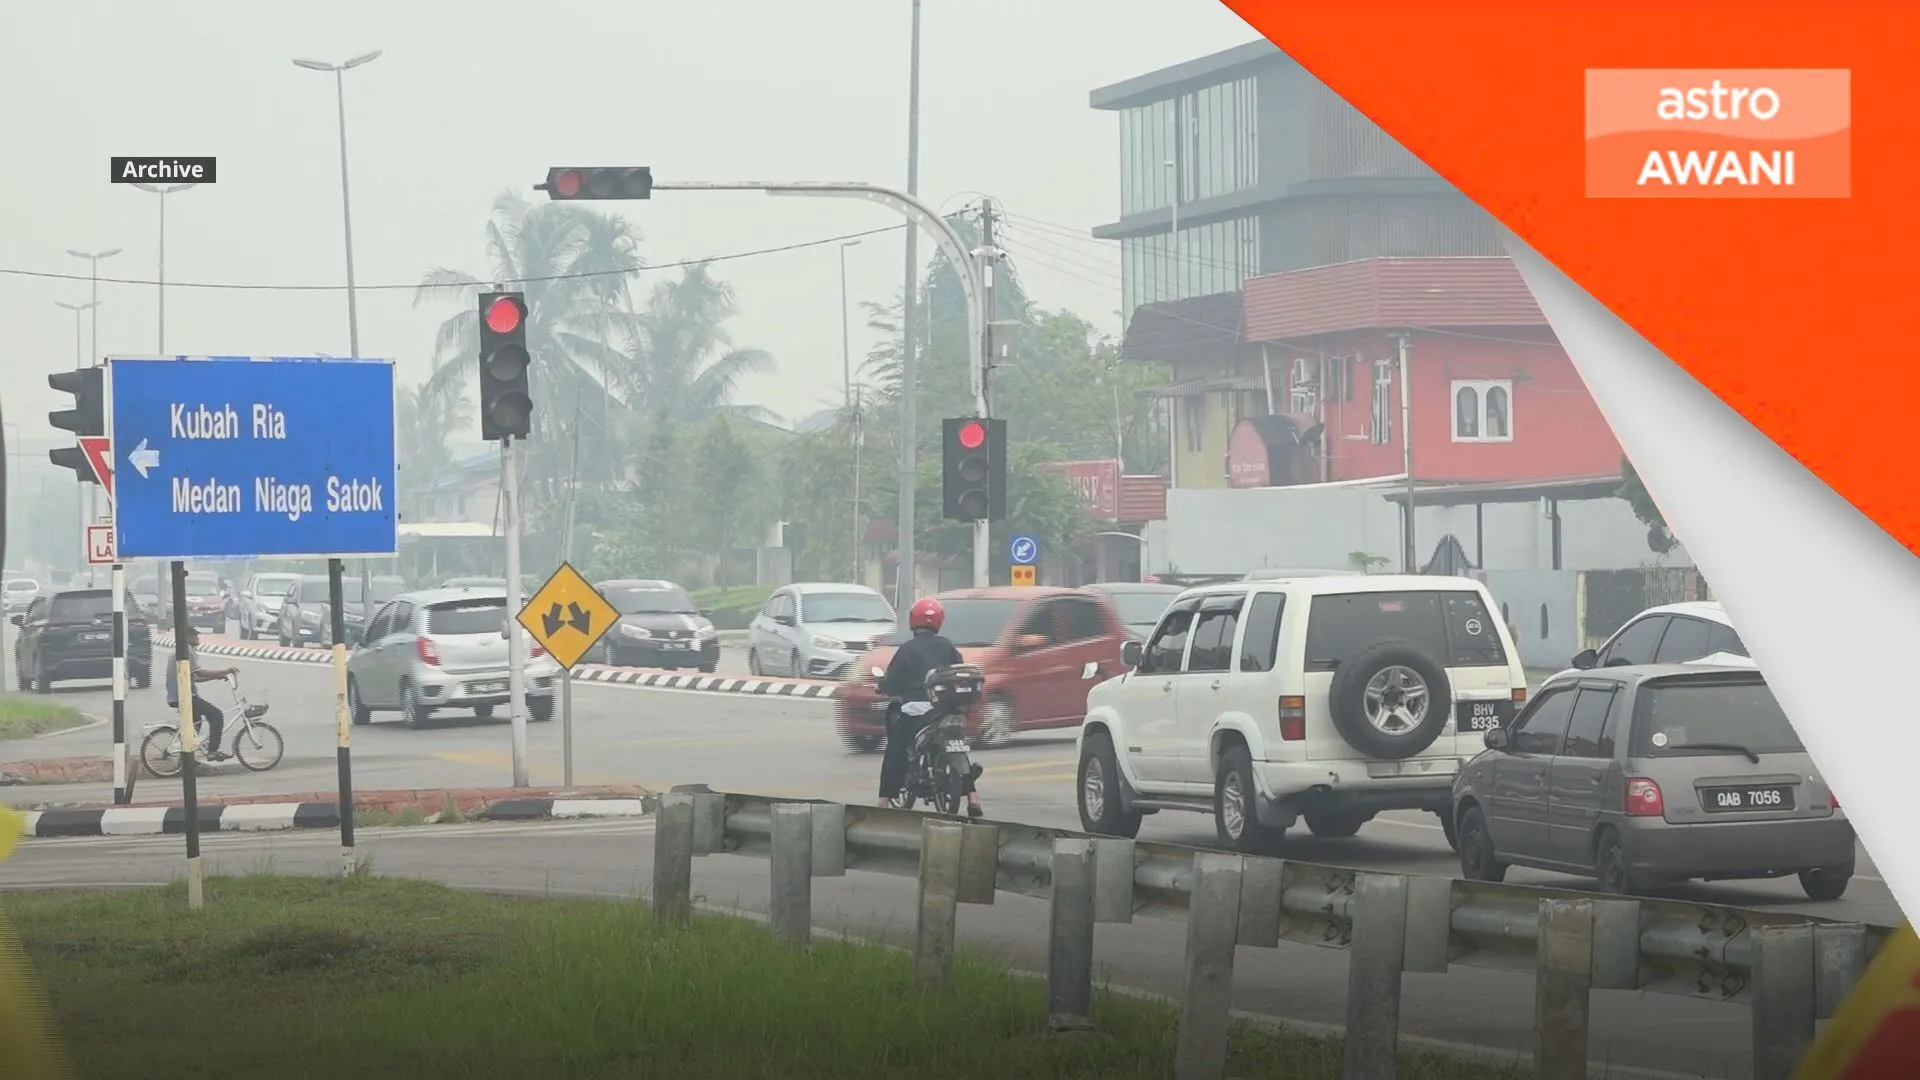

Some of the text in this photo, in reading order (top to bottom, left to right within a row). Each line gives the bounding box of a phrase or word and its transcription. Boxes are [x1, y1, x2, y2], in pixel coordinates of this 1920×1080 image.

[171, 403, 286, 439] Kubah Ria
[172, 475, 383, 521] Medan Niaga Satok
[1473, 703, 1495, 716] BHV
[1717, 790, 1781, 806] QAB 7056
